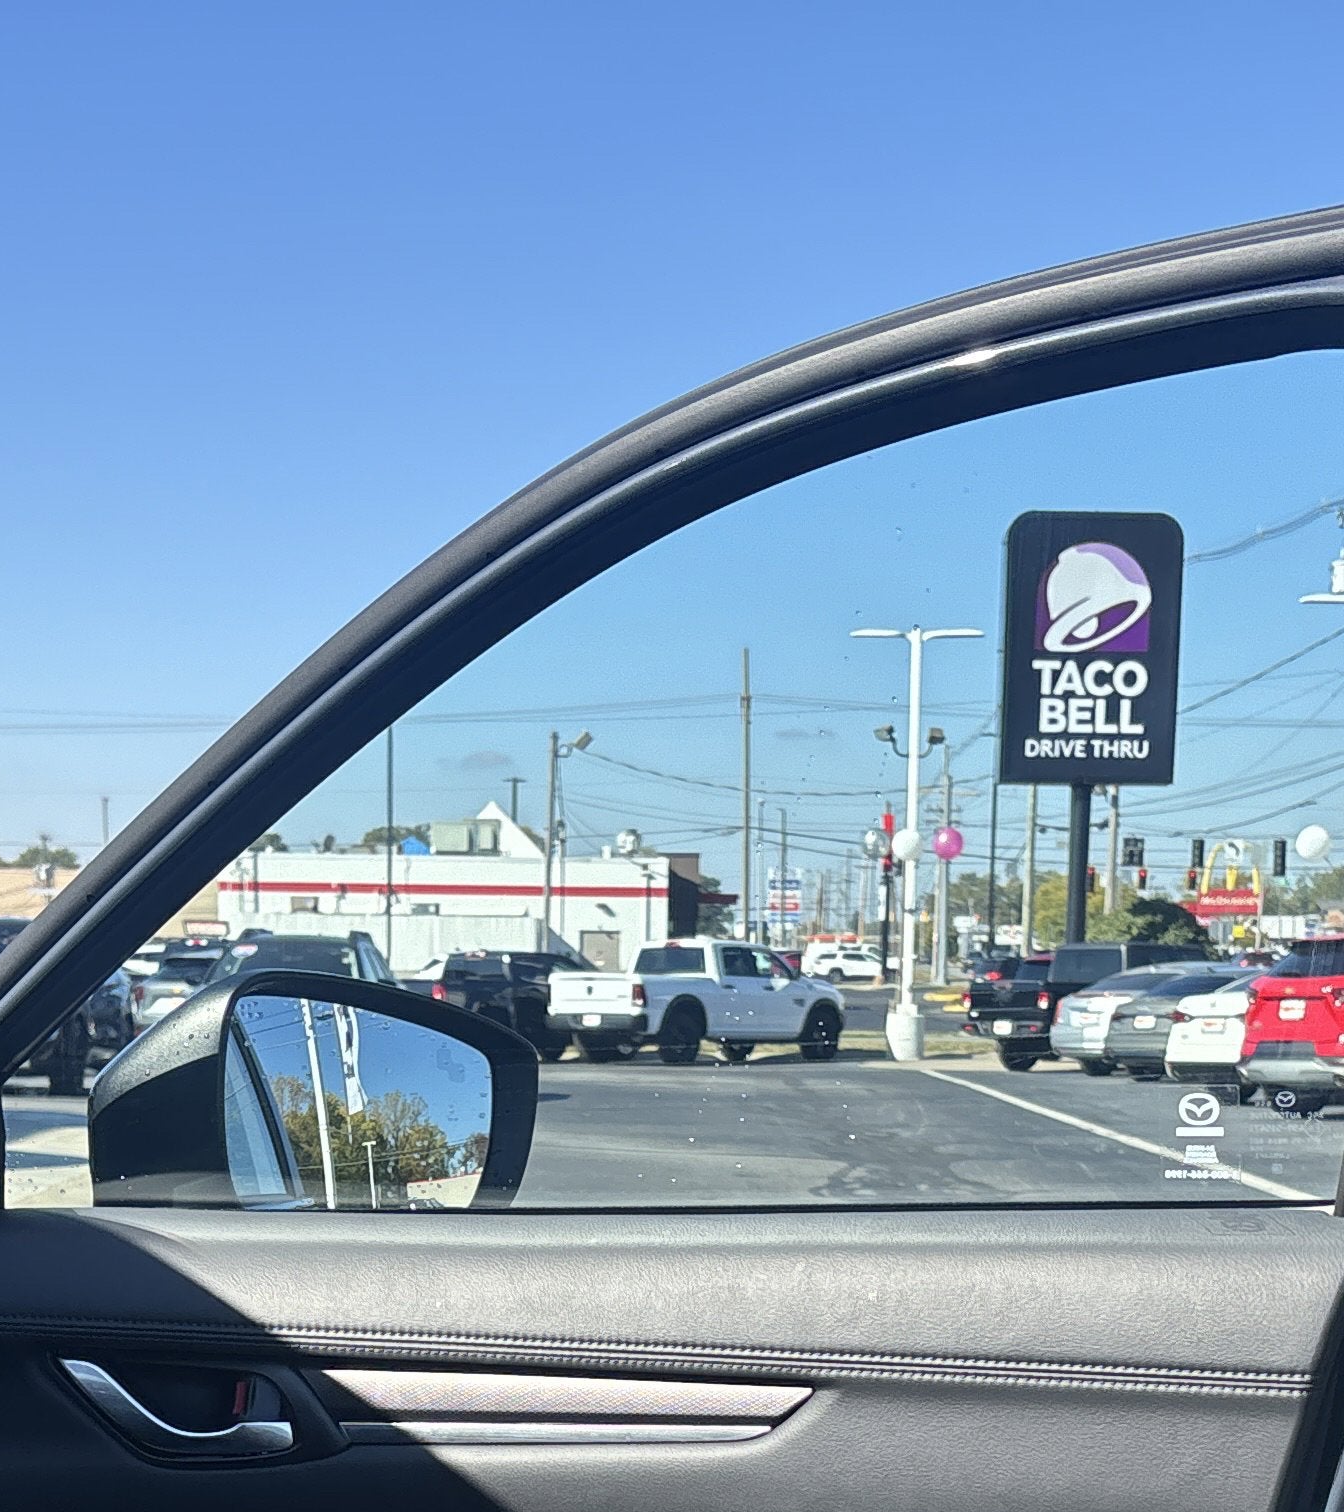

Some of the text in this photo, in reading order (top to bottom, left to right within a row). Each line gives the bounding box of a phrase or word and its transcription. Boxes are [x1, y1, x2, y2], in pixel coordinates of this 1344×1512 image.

[1032, 659, 1149, 697] TACO
[1038, 698, 1145, 734] BELL
[1024, 738, 1150, 760] DRIVE THRU
